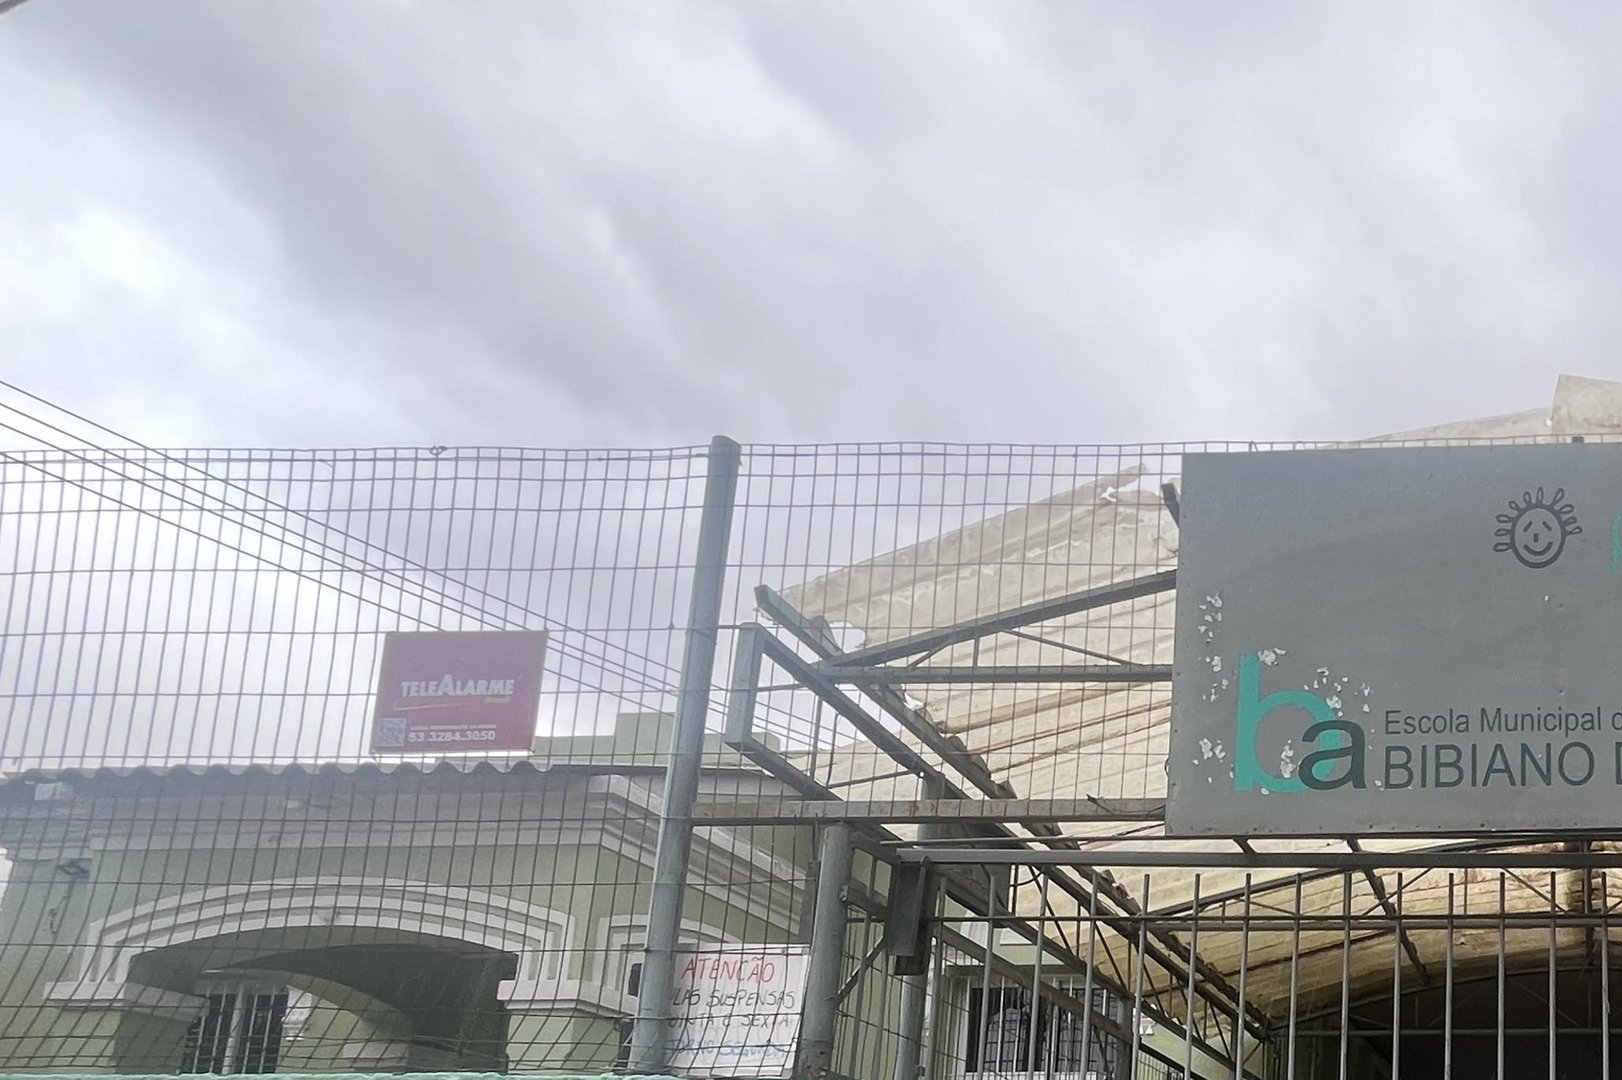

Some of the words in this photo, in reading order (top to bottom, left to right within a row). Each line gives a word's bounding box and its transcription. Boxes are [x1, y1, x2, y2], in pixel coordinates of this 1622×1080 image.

[1384, 708, 1470, 735] Escola
[1480, 706, 1602, 737] Municipal
[1383, 741, 1595, 790] BIBIANO
[673, 988, 701, 1006] LAS
